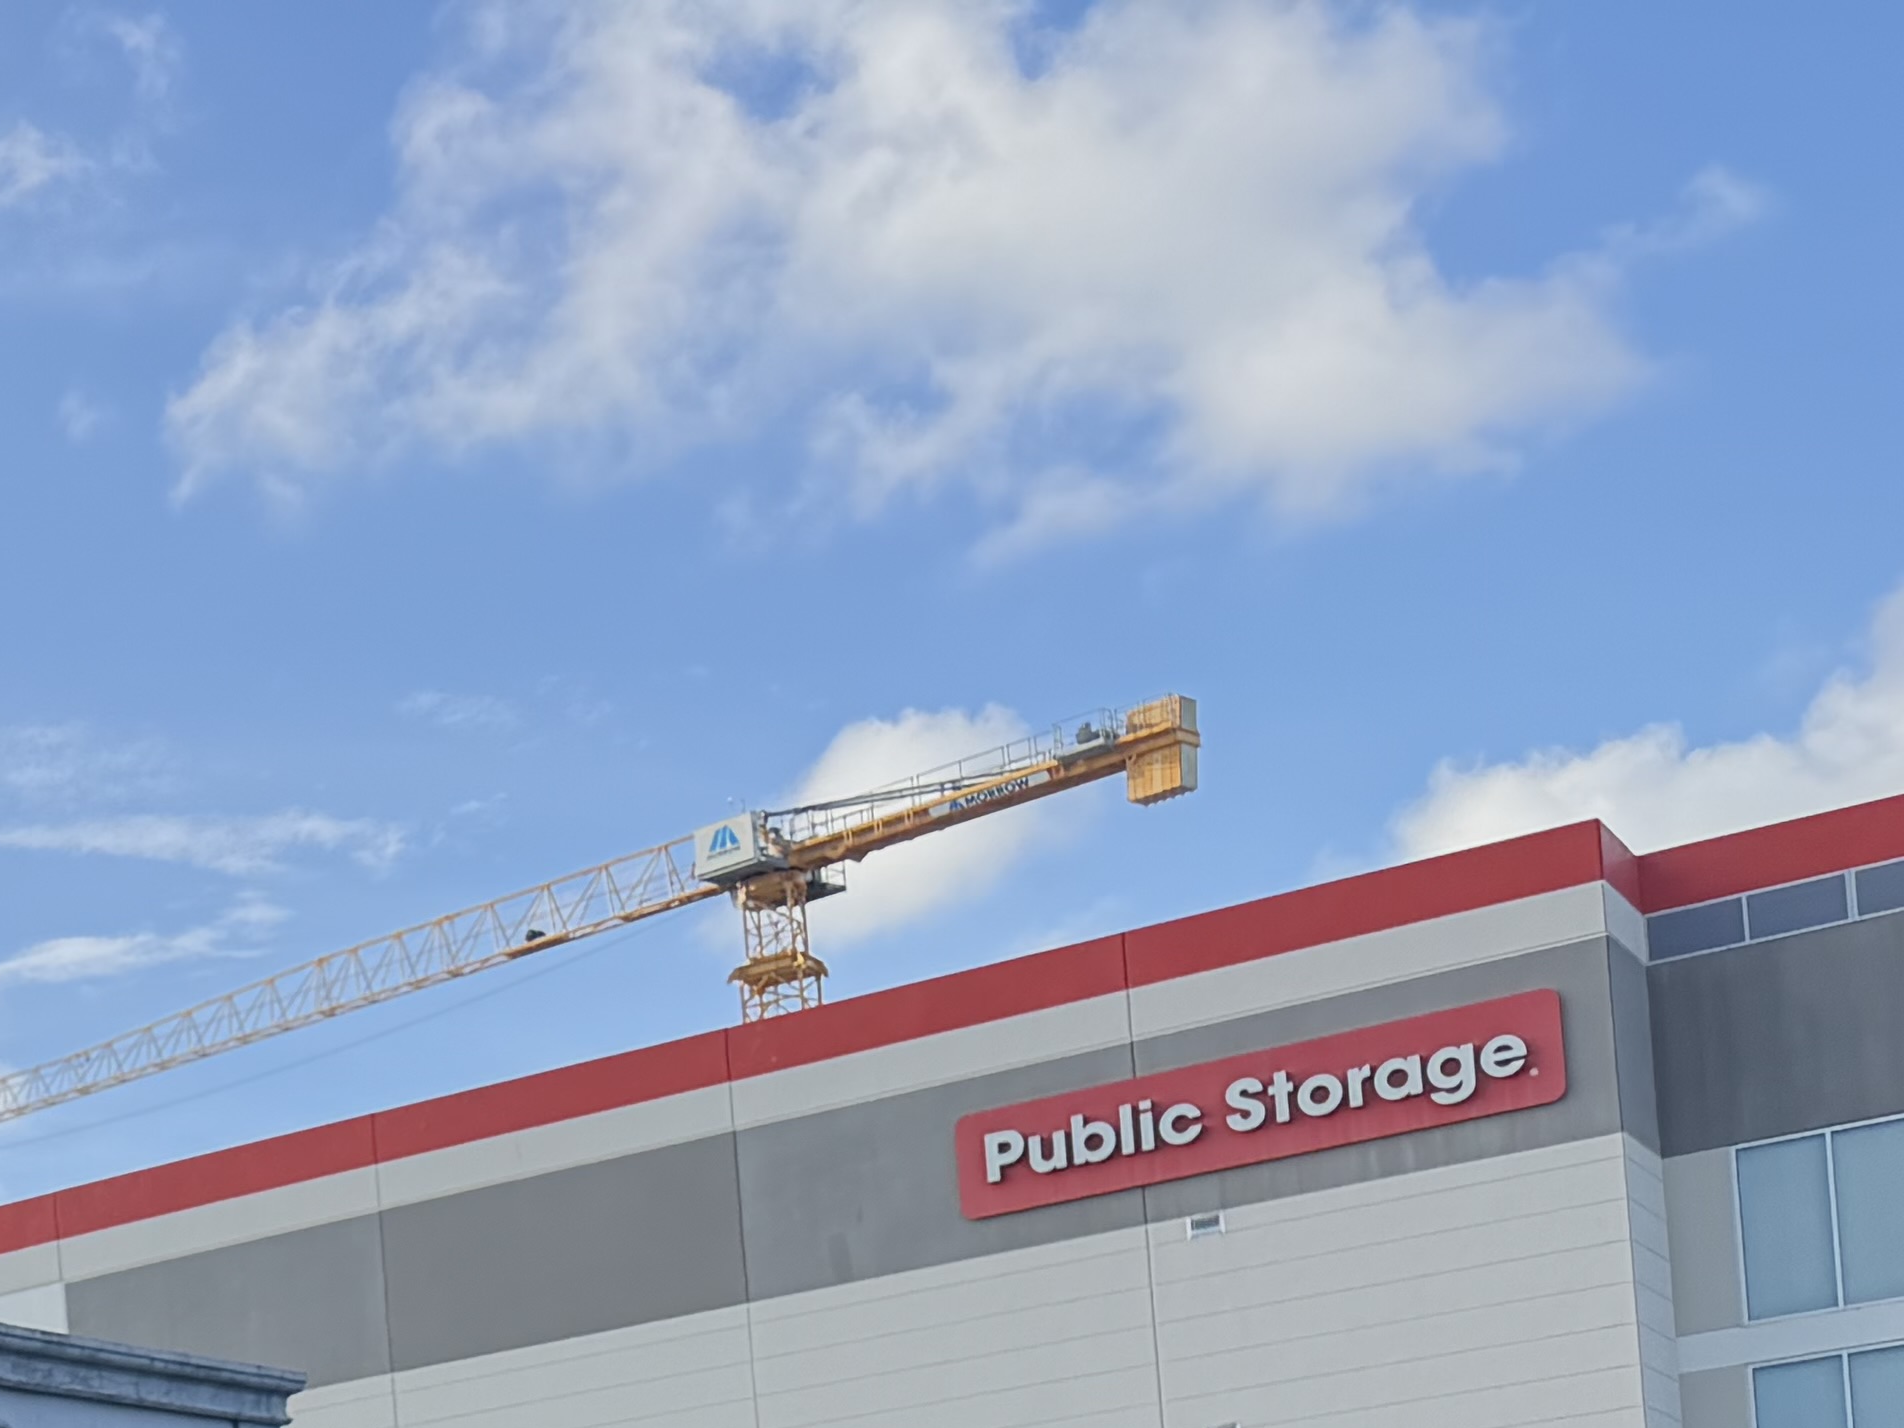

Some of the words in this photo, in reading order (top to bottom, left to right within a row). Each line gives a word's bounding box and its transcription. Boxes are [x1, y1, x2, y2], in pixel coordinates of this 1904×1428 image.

[965, 777, 1029, 806] MORROW
[983, 1099, 1202, 1182] Public
[1224, 1034, 1528, 1132] Storage
